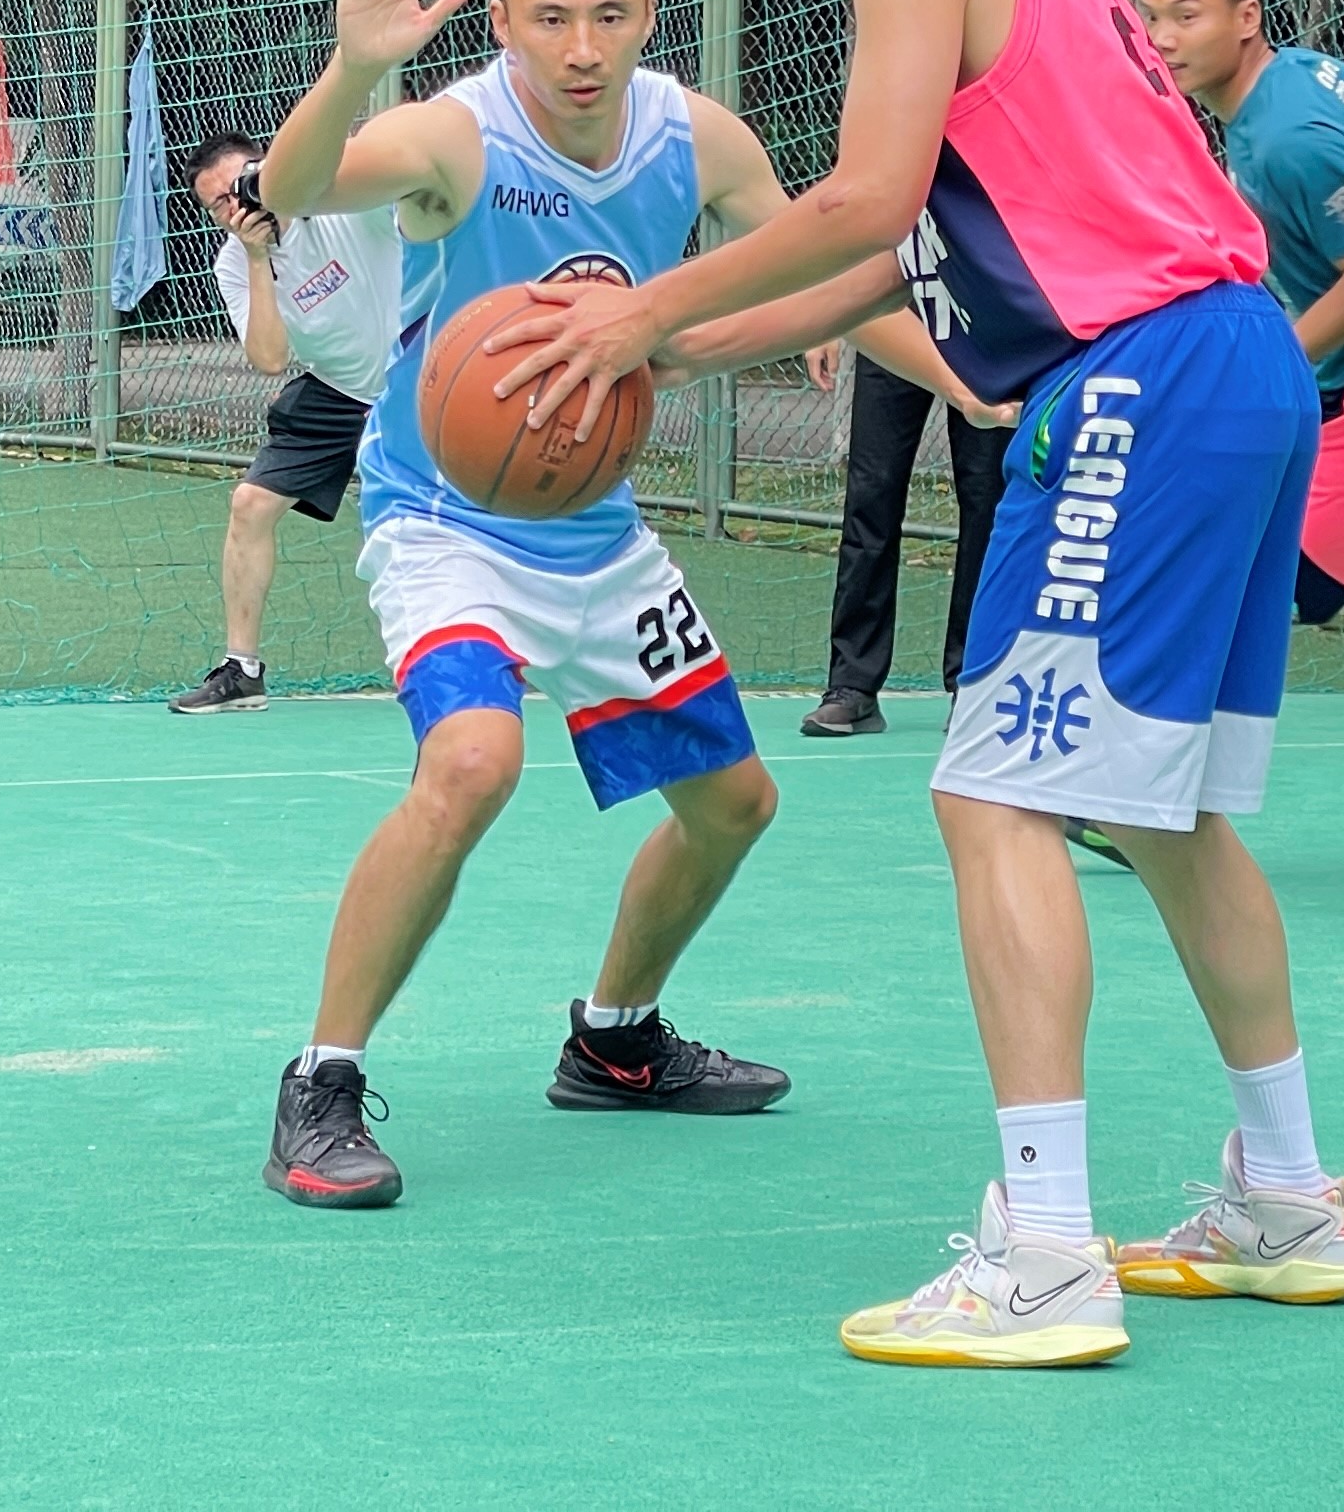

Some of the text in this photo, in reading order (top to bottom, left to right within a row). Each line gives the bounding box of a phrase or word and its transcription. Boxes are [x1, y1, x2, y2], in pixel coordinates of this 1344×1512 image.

[492, 185, 570, 217] MHWG
[1036, 377, 1142, 623] LEAGUE
[637, 588, 713, 684] 22
